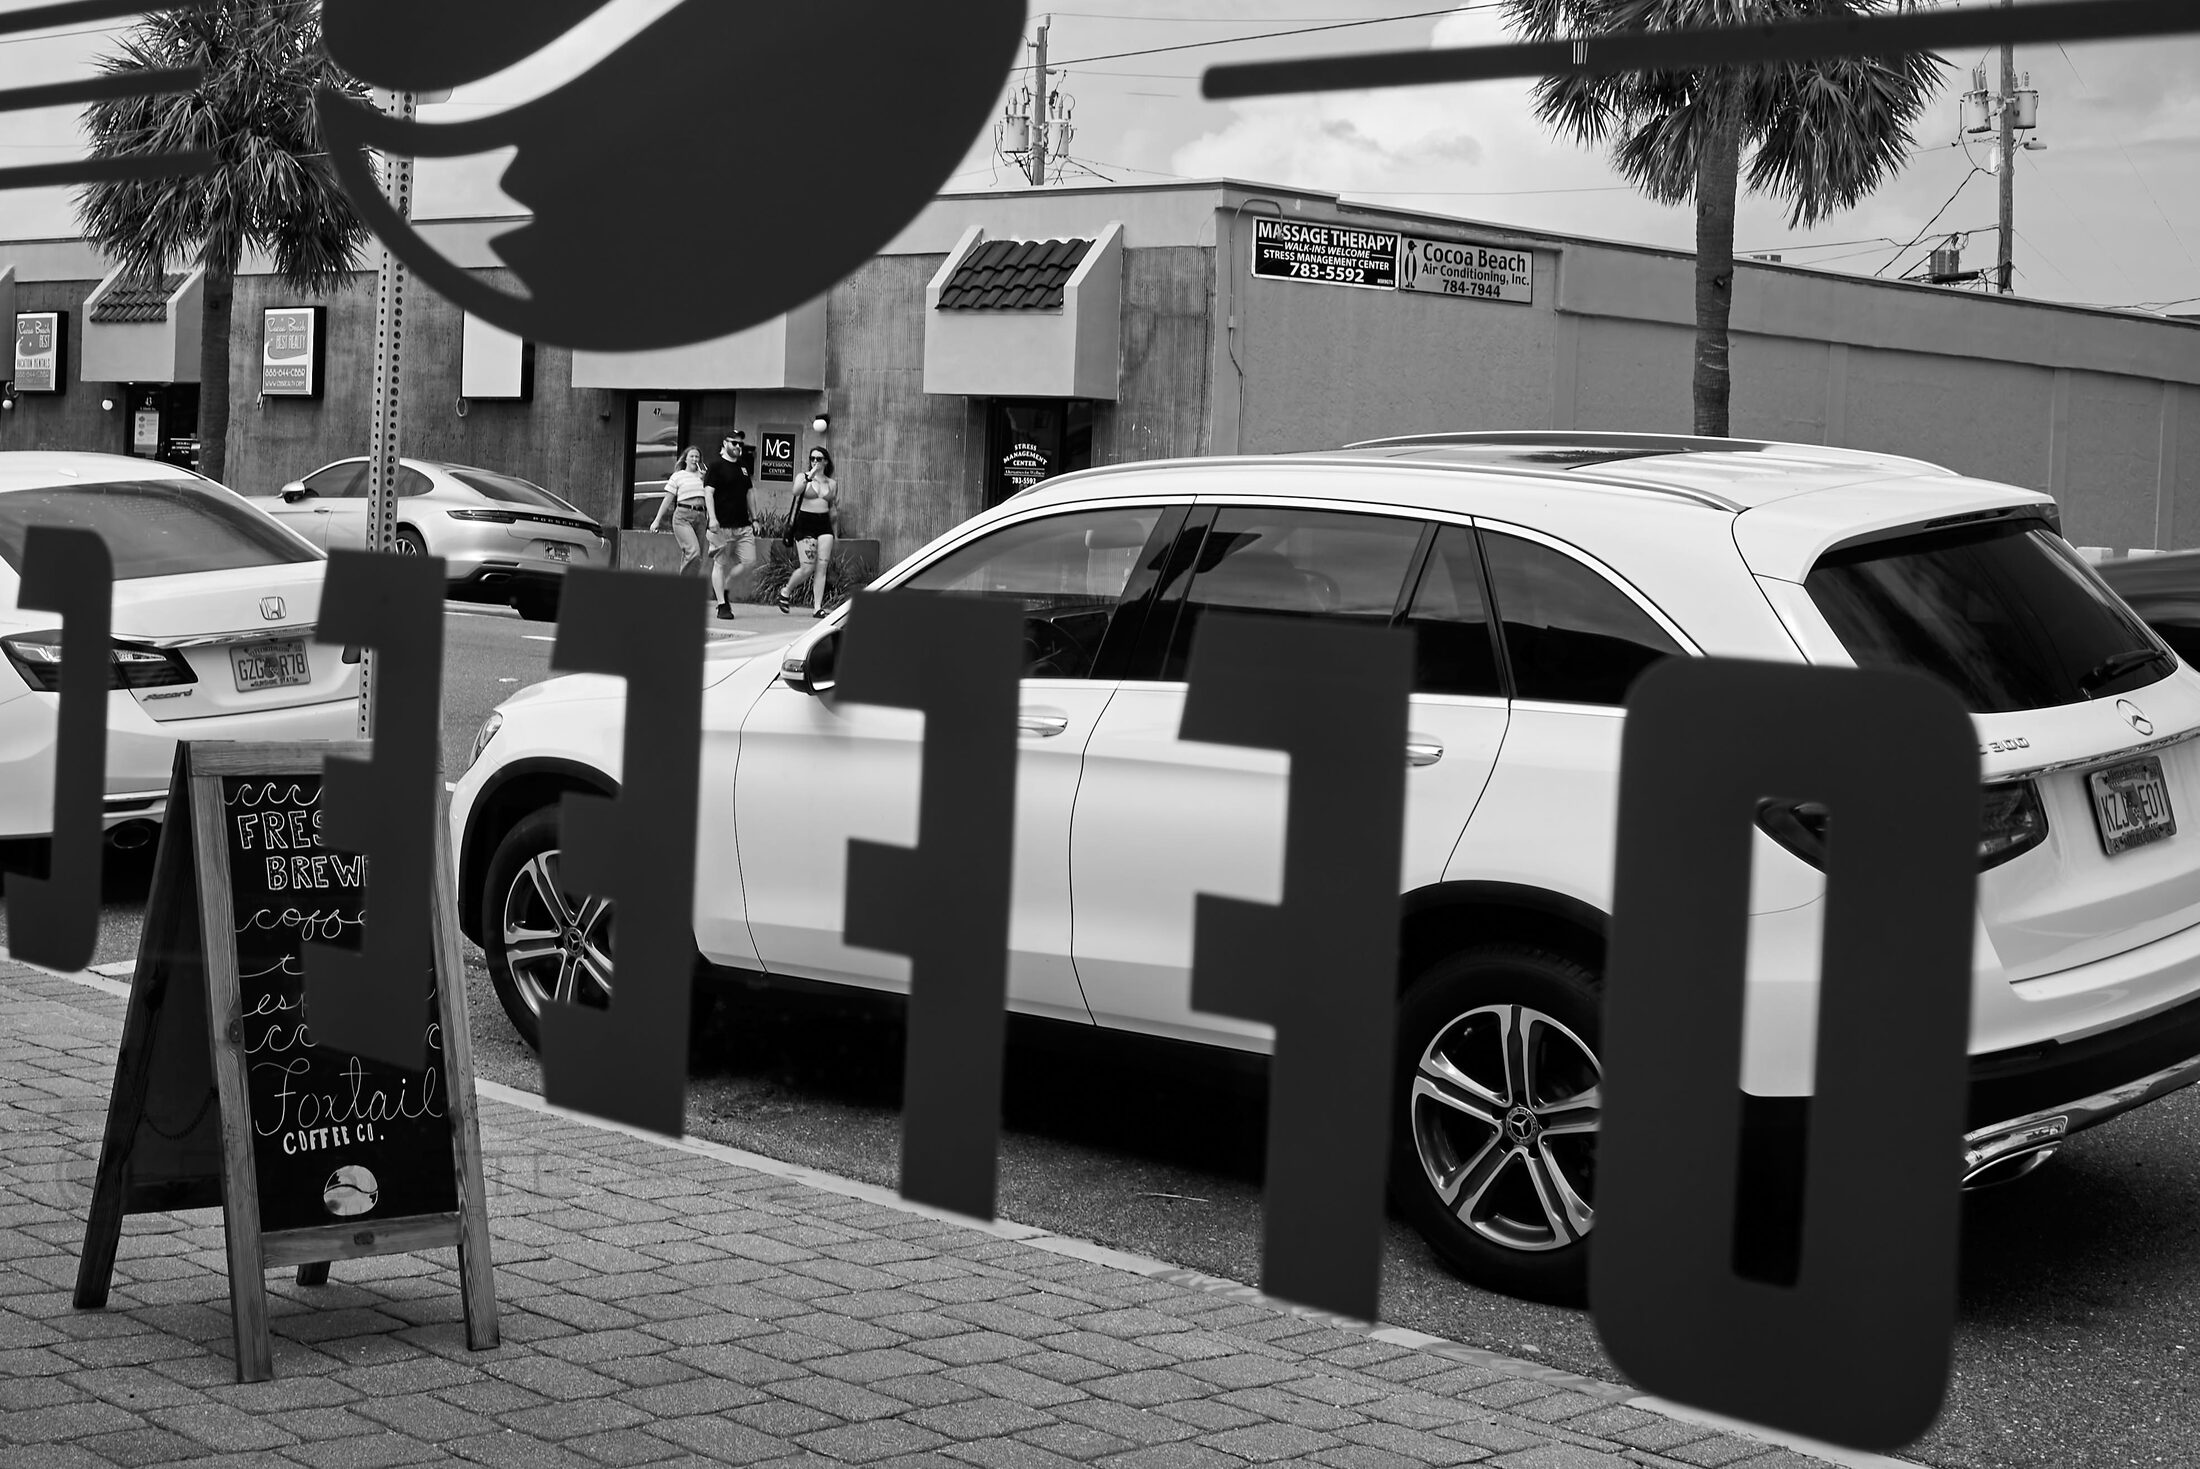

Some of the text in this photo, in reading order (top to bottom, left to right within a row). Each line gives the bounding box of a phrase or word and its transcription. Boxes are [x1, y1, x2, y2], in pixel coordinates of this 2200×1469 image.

[1258, 222, 1395, 252] MASSAGE THERAPY
[1263, 249, 1389, 271] STRESS MANAGEMENT CENTER
[1284, 242, 1370, 259] WALK-INS WELCOME
[1423, 243, 1526, 272] Cocoa Beach
[1289, 262, 1365, 283] 783-5592
[1421, 262, 1530, 286] Air Conditioning, Inc.
[1442, 280, 1501, 297] 784-7944
[765, 438, 790, 459] MG
[1003, 450, 1048, 465] MANAGEMENT
[1014, 443, 1037, 451] STRESS
[532, 516, 580, 527] PORSCHE
[238, 653, 306, 680] GZG R78
[142, 689, 193, 701] Accord
[1989, 737, 2030, 752] 300
[2100, 792, 2130, 832] KZJ
[237, 810, 324, 850] FRES
[265, 854, 369, 891] BREW
[252, 1056, 443, 1136] Foxtail
[283, 1123, 385, 1155] COFFEE CO.
